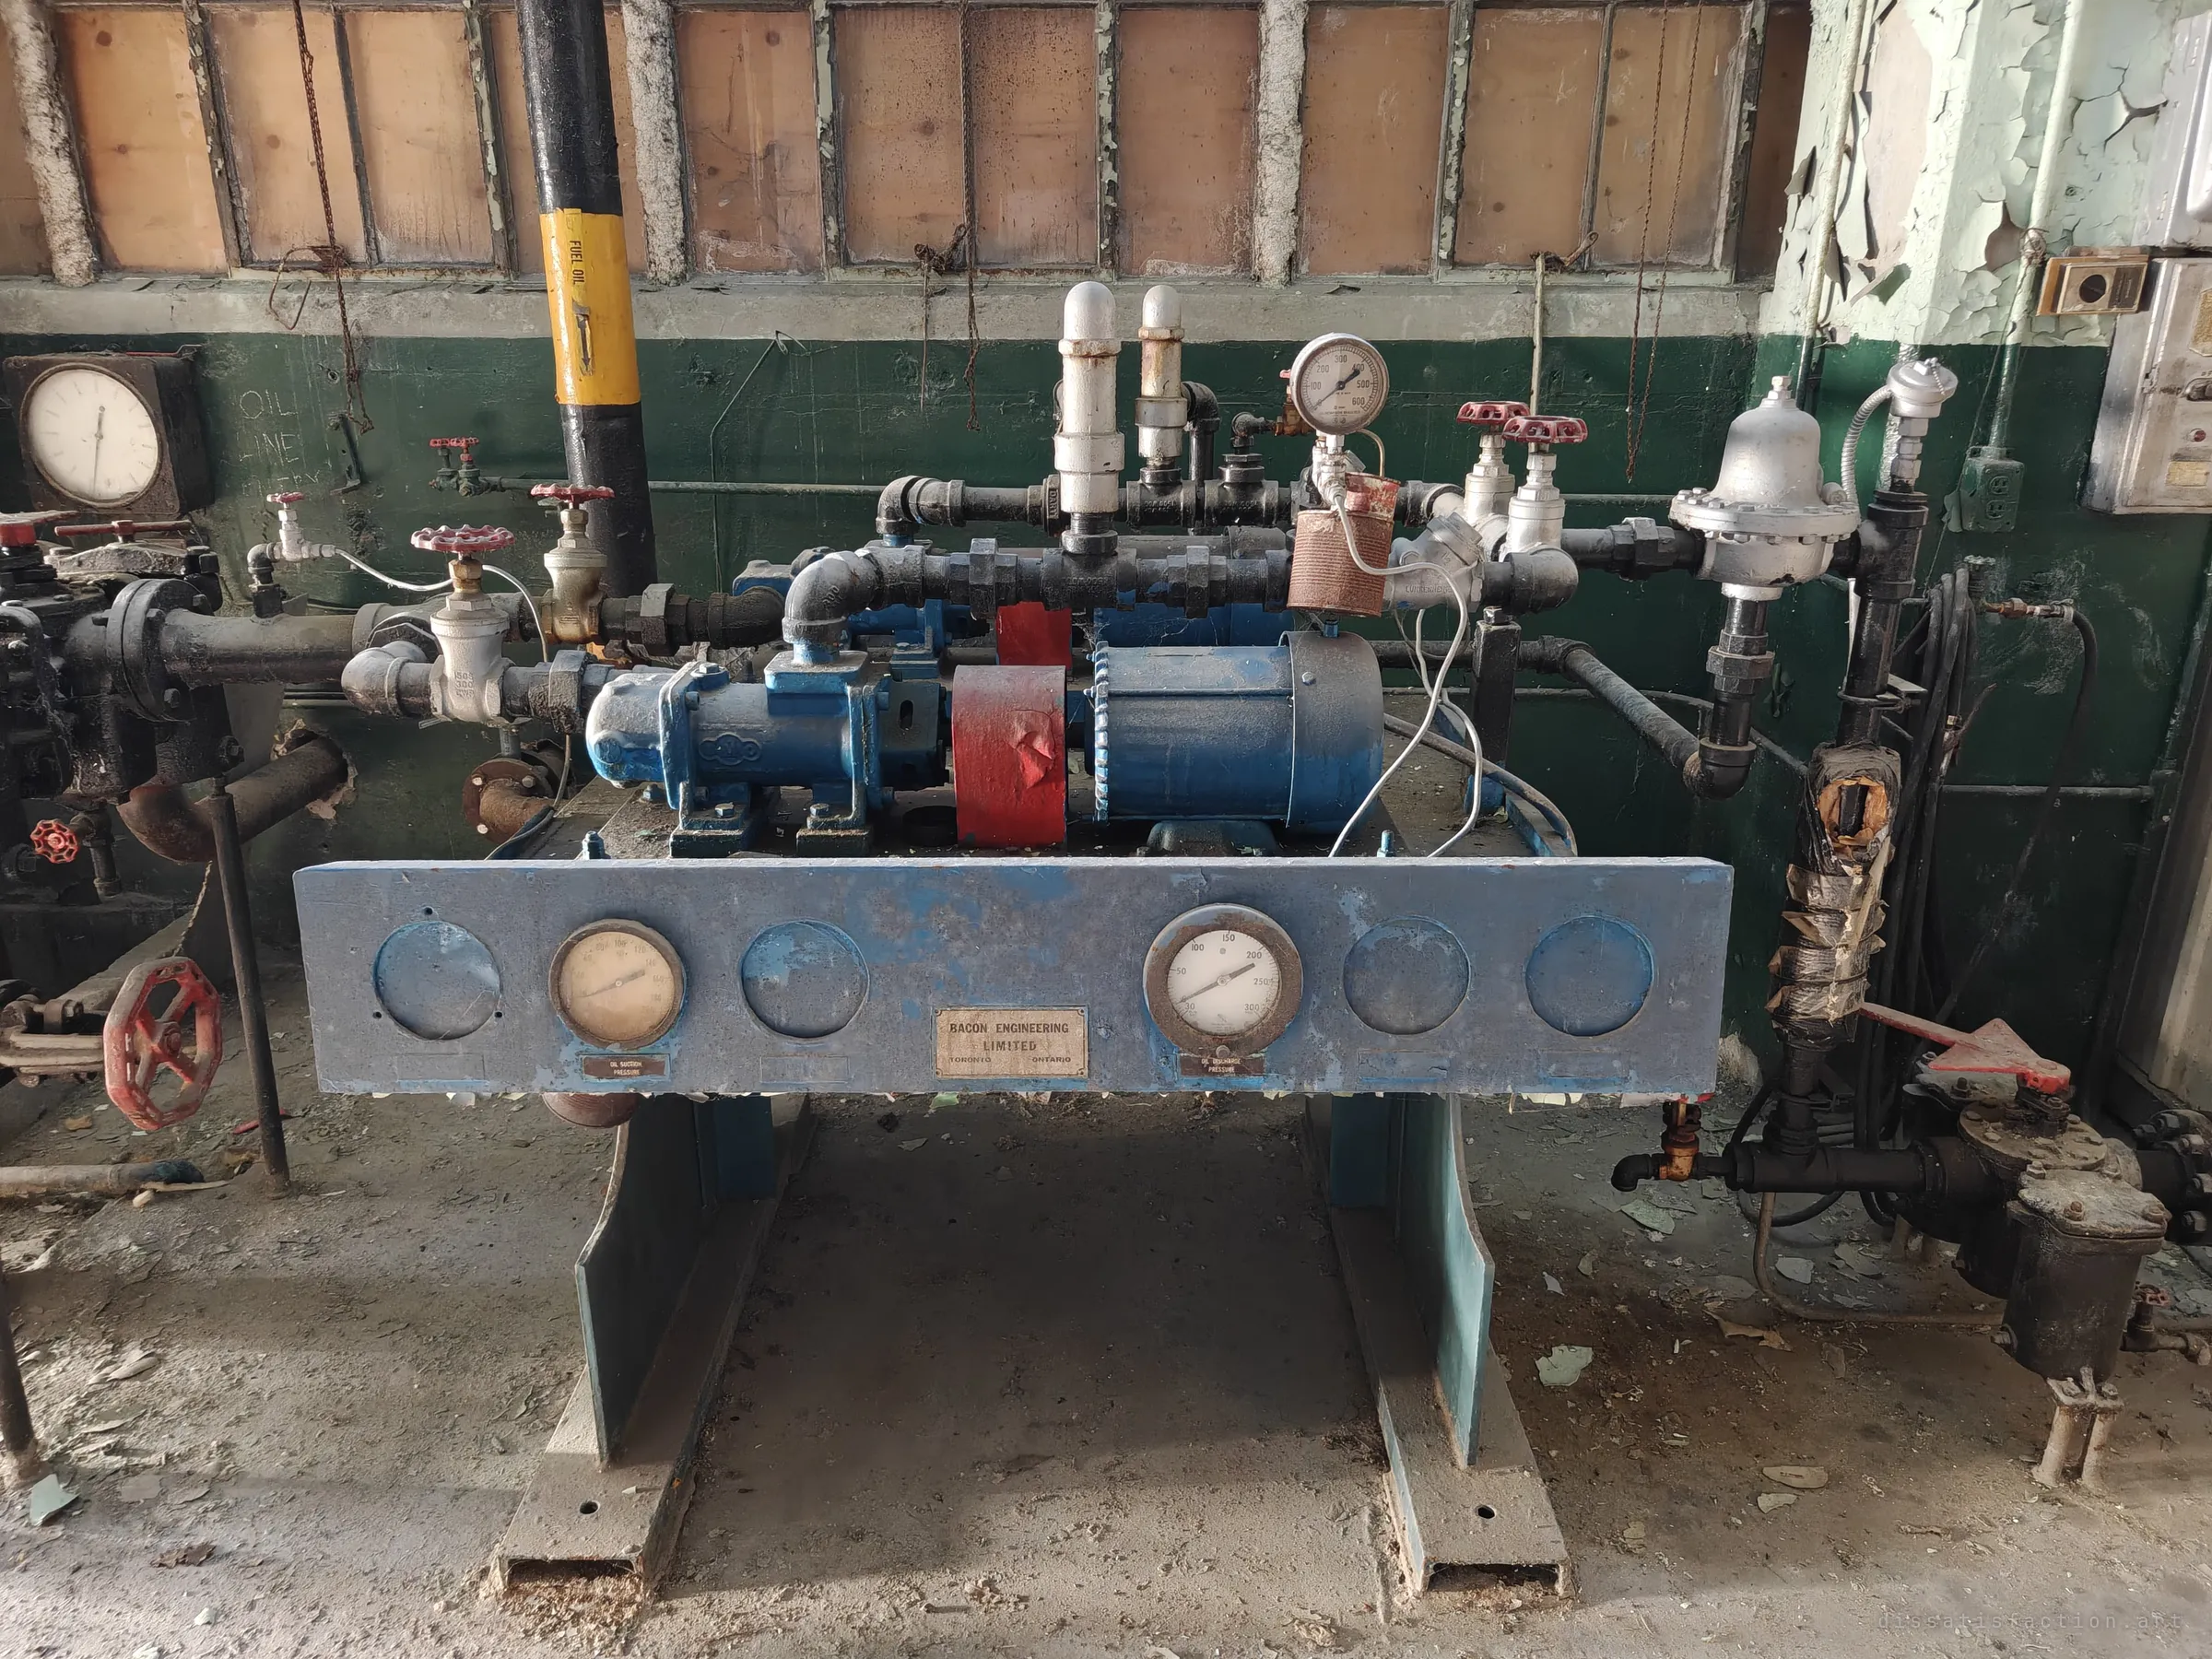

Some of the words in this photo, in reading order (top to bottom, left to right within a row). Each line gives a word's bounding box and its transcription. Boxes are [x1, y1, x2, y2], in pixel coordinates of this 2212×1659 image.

[570, 241, 583, 265] FUEL
[572, 269, 585, 285] OIL
[1335, 355, 1347, 363] 300
[1317, 365, 1330, 373] 200
[1352, 364, 1364, 372] 400
[1310, 382, 1322, 390] 100
[1357, 380, 1370, 389] 500
[240, 389, 299, 419] OIL
[1352, 397, 1365, 406] 600
[1222, 934, 1235, 943] 150
[1191, 943, 1205, 952] 100
[1246, 951, 1262, 959] 200
[1176, 967, 1186, 975] 50
[1253, 977, 1268, 986] 250
[1185, 1002, 1195, 1010] 30
[1244, 1003, 1260, 1011] 300
[949, 1023, 987, 1033] BACON
[995, 1023, 1069, 1033] ENGINEERING
[983, 1041, 1037, 1051] LIMITED
